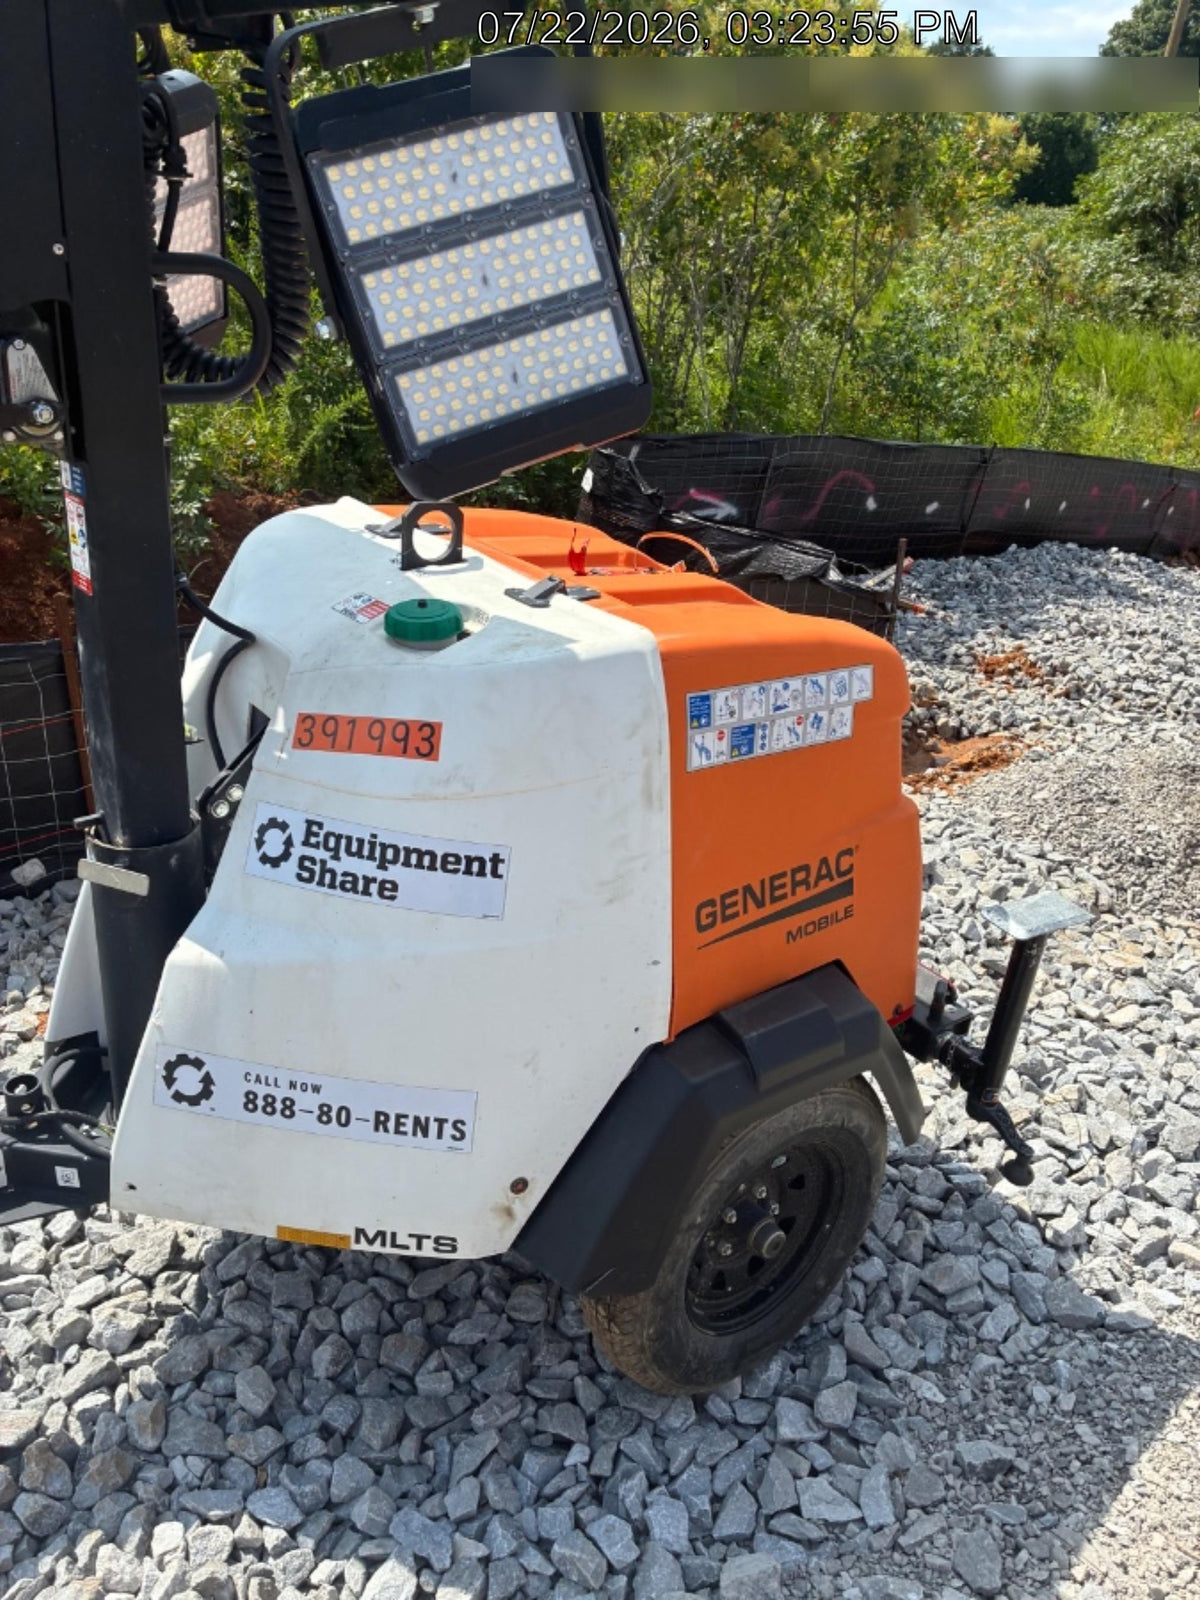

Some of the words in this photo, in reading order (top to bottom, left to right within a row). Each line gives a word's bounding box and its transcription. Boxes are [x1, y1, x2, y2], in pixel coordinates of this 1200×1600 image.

[297, 715, 435, 758] 391993
[301, 818, 506, 879] Equipment
[295, 854, 399, 901] Share
[695, 847, 854, 934] GENERAC
[786, 904, 855, 945] MOBILE
[244, 1071, 281, 1089] CALL
[289, 1080, 323, 1095] NOW
[354, 1227, 459, 1255] MLTS
